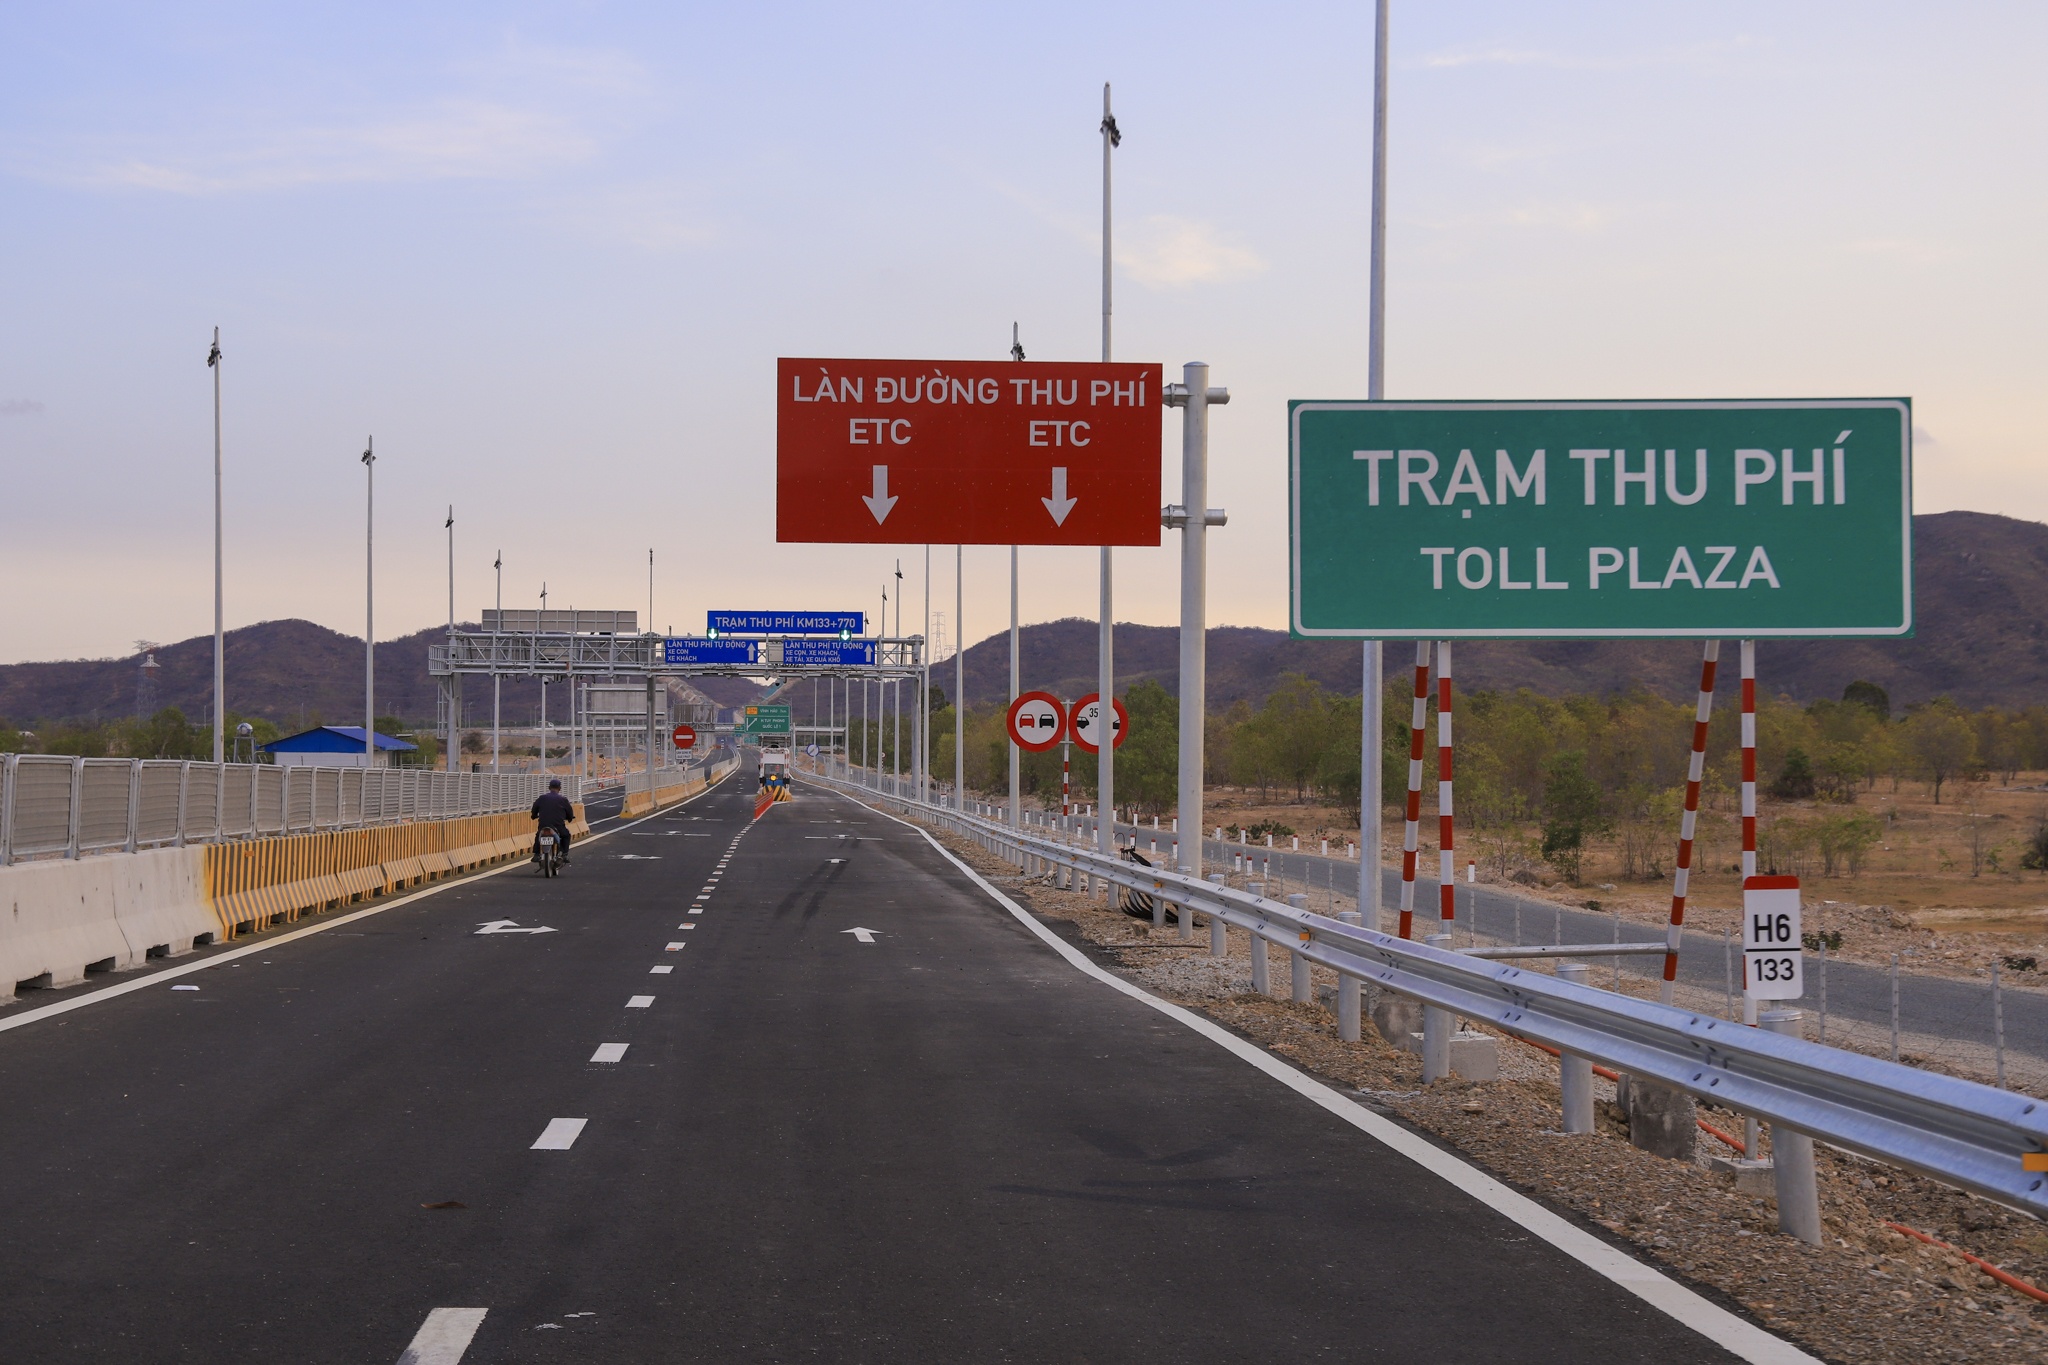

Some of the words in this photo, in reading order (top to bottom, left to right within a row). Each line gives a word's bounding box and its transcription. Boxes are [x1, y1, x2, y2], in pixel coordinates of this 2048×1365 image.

[793, 367, 863, 403] LÀN
[875, 369, 999, 405] ĐƯỜNG
[1009, 379, 1078, 406] THU
[1090, 371, 1149, 407] PHÍ
[849, 418, 912, 445] ETC
[1029, 420, 1091, 447] ETC
[1352, 449, 1547, 519] TRẠM
[1569, 448, 1707, 506] THU
[1733, 429, 1853, 505] PHÍ
[1420, 546, 1569, 590] TOLL
[1588, 545, 1781, 589] PLAZA
[715, 617, 747, 629] TRẠM
[749, 617, 772, 628] THU
[775, 615, 795, 628] PHÍ
[797, 618, 856, 628] KM133+770
[667, 640, 682, 648] LÀN
[700, 640, 713, 648] PHÍ
[785, 641, 800, 649] LÀN
[818, 641, 830, 649] PHÍ
[1753, 913, 1791, 943] H6
[1753, 958, 1794, 981] 133
